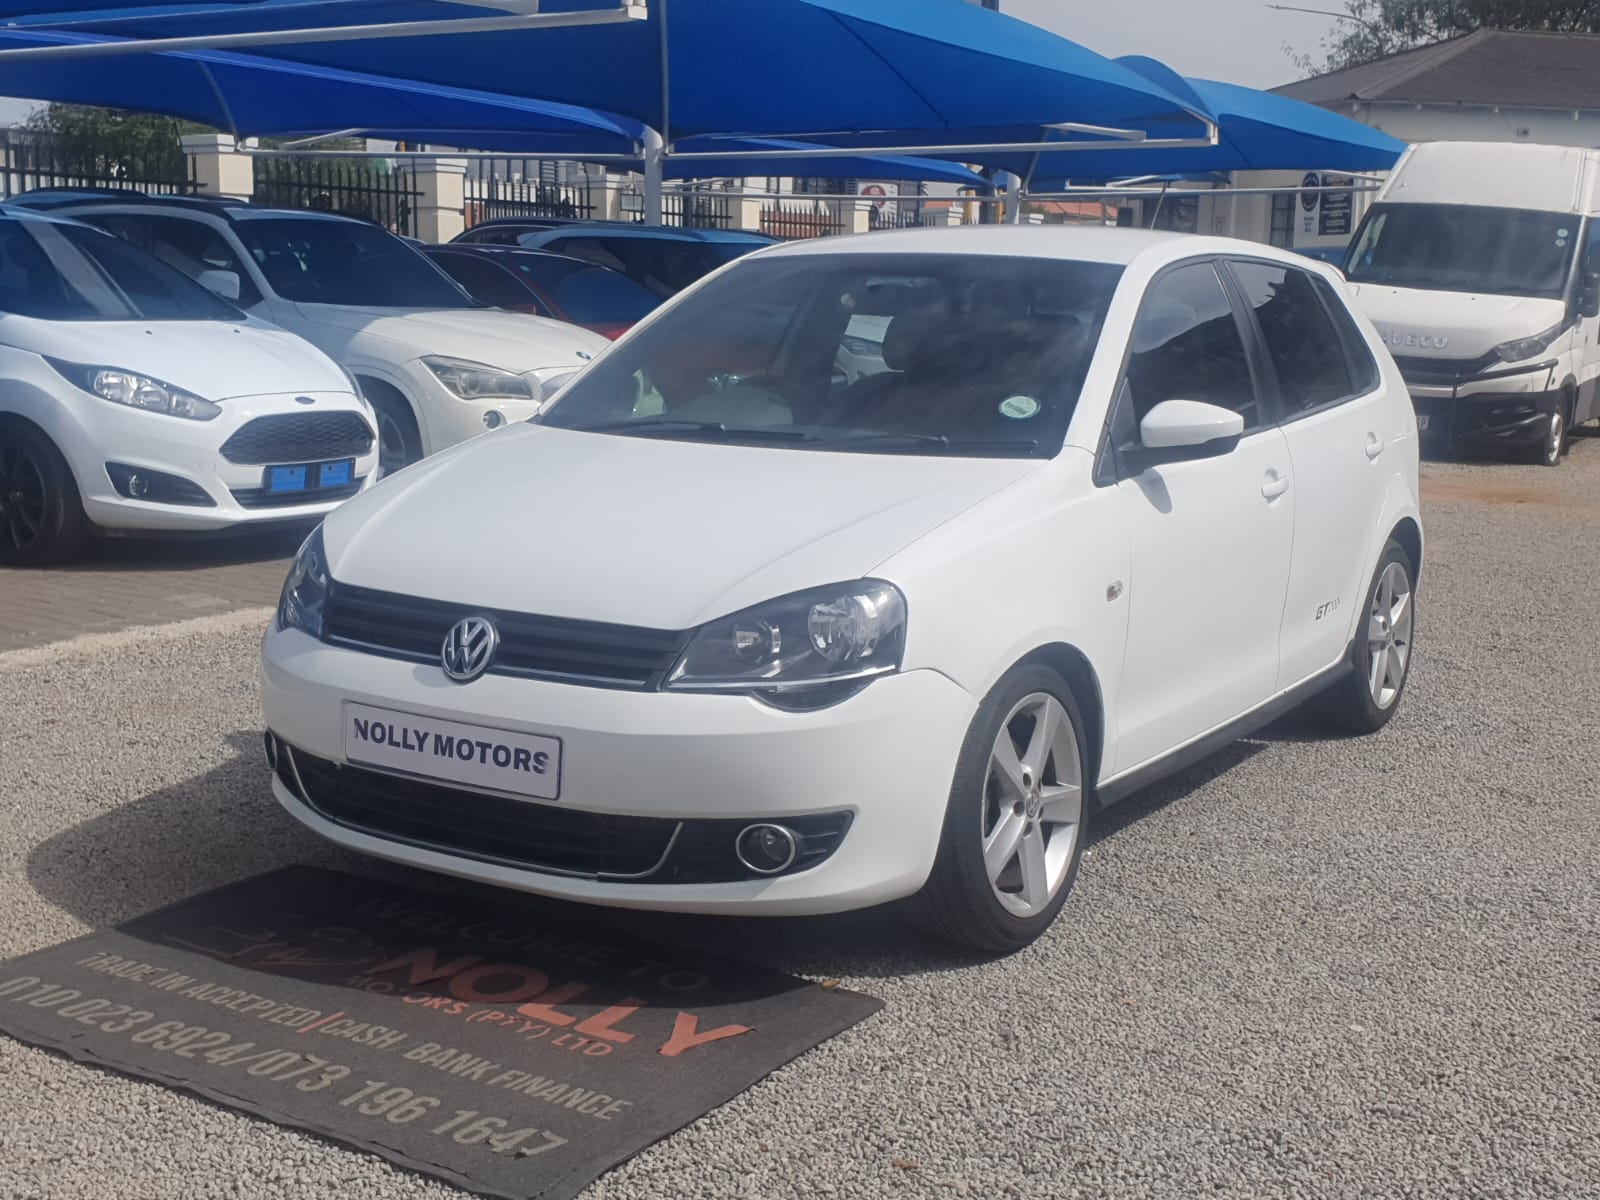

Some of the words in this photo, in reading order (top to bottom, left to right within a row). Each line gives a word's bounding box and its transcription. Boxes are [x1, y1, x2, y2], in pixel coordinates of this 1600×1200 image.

[353, 717, 430, 753] NOLLY
[433, 733, 550, 775] MOTORS
[343, 975, 470, 1015] MOORS
[465, 1009, 551, 1040] (PTY)
[551, 1032, 614, 1056] LTD
[367, 947, 757, 1056] NOLLY
[628, 957, 708, 991] TO
[0, 975, 82, 1008] 010
[57, 998, 154, 1032] 023
[339, 1079, 441, 1124] 196
[431, 1110, 569, 1156] 1647
[75, 952, 168, 982] TRADE
[403, 1042, 501, 1080] BANK
[487, 1069, 633, 1120] FINANCE
